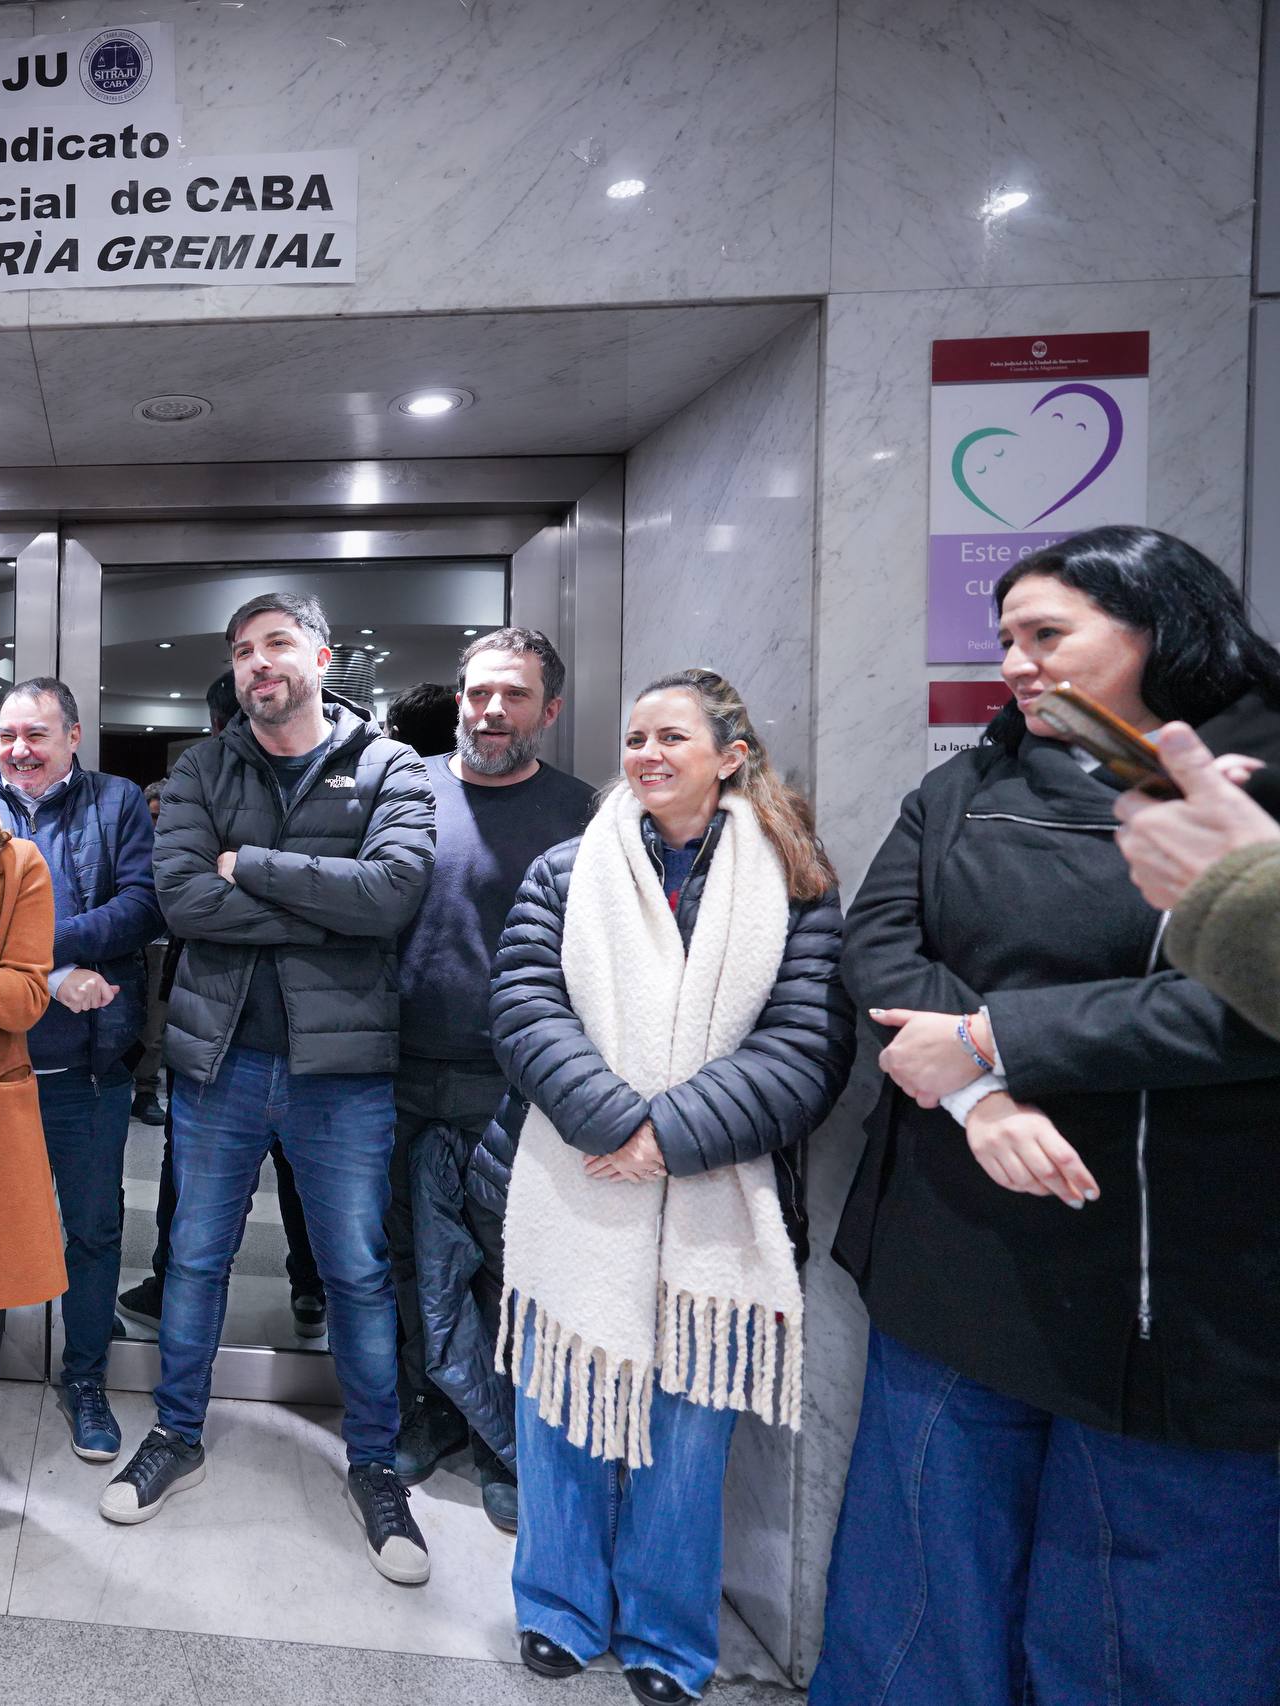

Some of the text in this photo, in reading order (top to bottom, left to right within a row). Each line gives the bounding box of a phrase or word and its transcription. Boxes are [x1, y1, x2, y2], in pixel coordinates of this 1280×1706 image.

[94, 68, 138, 80] SITRAJU
[103, 80, 128, 89] CABA
[110, 180, 172, 216] de
[185, 173, 334, 213] CABA
[96, 232, 342, 273] GREMIAL
[961, 542, 1011, 563] Este
[967, 640, 995, 650] Pedir
[933, 742, 947, 752] La
